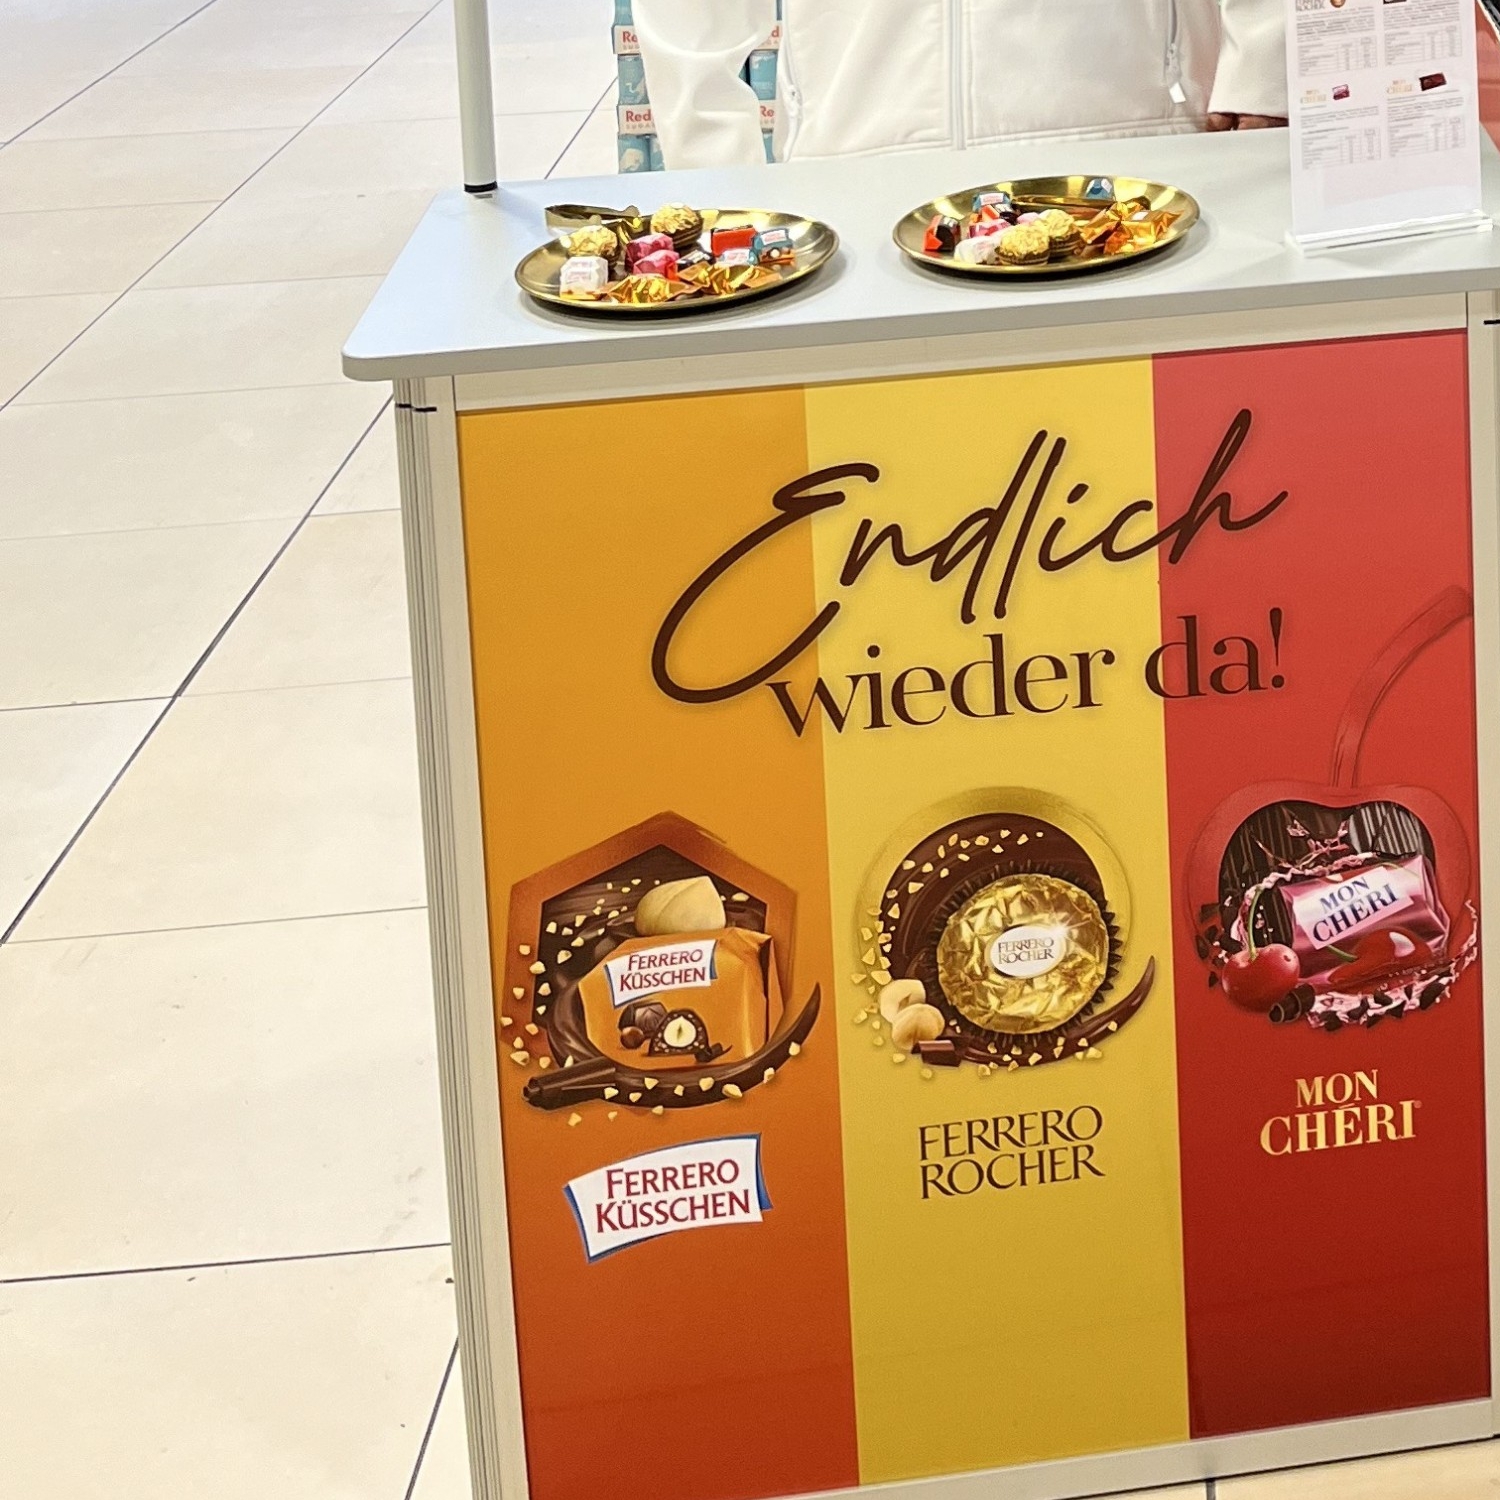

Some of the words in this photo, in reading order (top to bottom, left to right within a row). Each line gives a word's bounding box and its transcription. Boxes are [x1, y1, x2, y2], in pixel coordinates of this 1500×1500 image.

[622, 31, 638, 43] Re
[626, 109, 651, 122] Red
[760, 106, 775, 117] Re
[651, 409, 1289, 704] Endlich
[766, 633, 1116, 737] wieder
[1144, 607, 1287, 703] da!
[1321, 876, 1370, 914] MON
[628, 949, 704, 971] FERRERO
[998, 937, 1054, 952] FERRERO
[999, 949, 1054, 964] ROCHER
[620, 967, 706, 991] KÜSSCHEN
[1296, 1069, 1378, 1108] MON
[919, 1105, 1102, 1161] FERRERO
[1260, 1100, 1416, 1156] CHÉRI
[607, 1159, 739, 1199] FERRERO
[920, 1144, 1106, 1199] ROCHER
[596, 1189, 750, 1233] KÜSSCHEN
